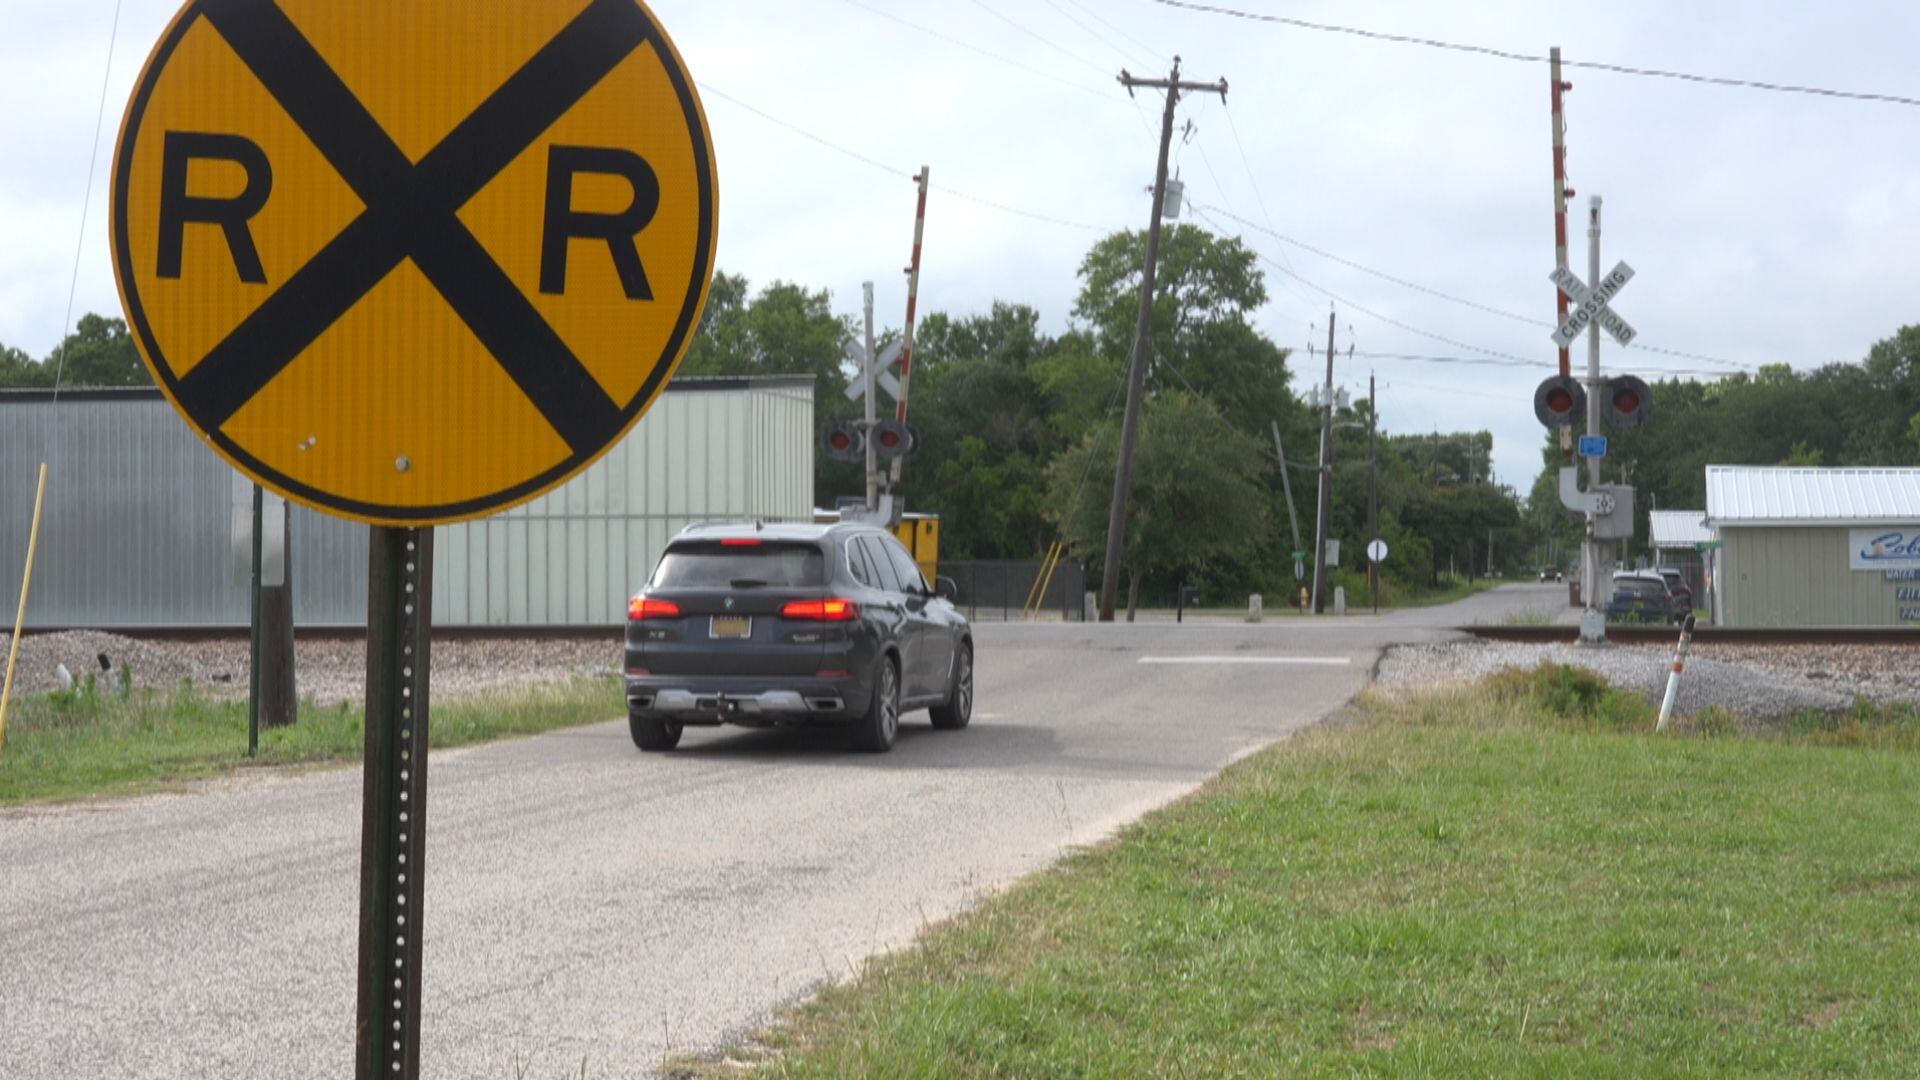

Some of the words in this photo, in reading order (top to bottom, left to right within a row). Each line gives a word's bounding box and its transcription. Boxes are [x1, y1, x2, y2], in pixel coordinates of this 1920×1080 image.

[156, 130, 273, 285] R
[539, 144, 660, 301] R
[1562, 271, 1625, 338] CROSSING
